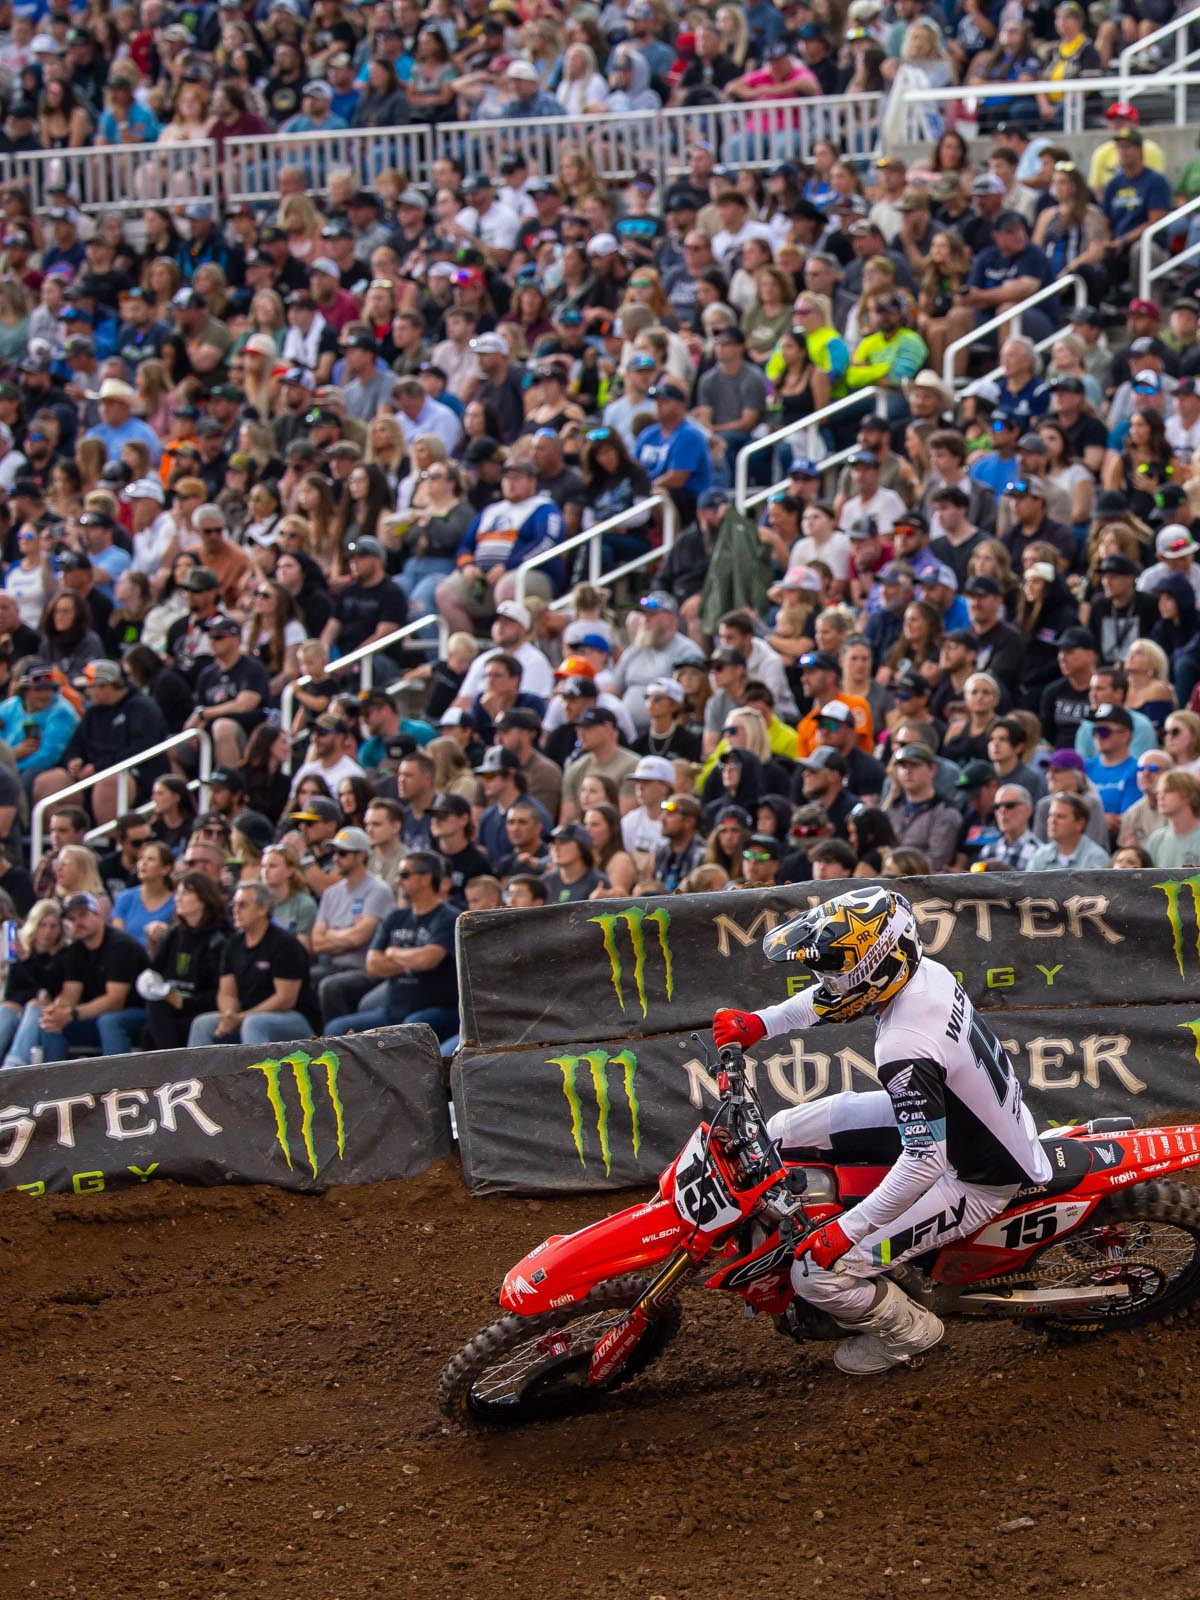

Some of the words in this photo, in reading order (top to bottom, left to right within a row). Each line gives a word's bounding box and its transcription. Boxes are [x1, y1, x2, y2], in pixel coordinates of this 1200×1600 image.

[712, 894, 1126, 958] MSTER
[675, 1152, 728, 1226] 15
[1109, 1169, 1137, 1186] froth
[641, 1226, 681, 1244] WILSON
[914, 1194, 967, 1248] FLY
[1001, 1205, 1058, 1249] 15
[549, 1293, 575, 1309] froth
